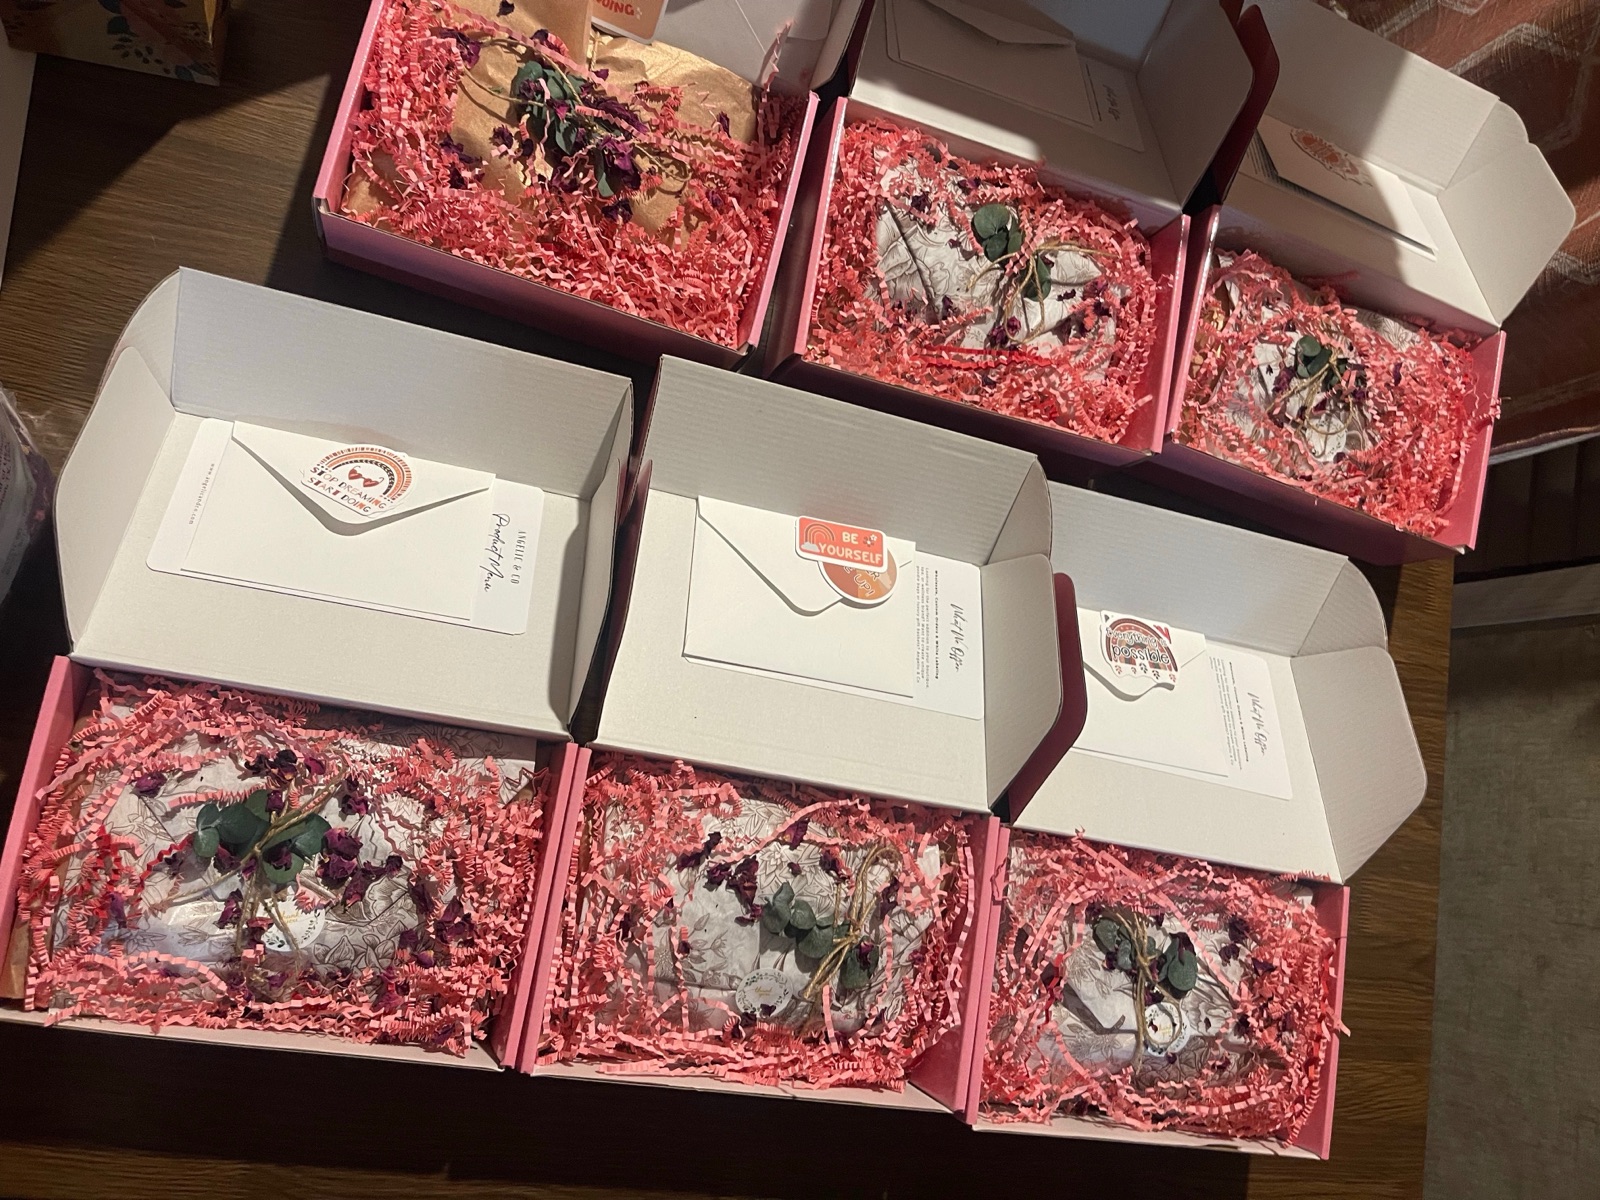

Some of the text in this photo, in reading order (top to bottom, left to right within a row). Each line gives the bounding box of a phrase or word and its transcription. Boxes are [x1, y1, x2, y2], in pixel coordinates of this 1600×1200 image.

[307, 476, 372, 513] START DOING
[309, 466, 387, 509] STOP DREAMING
[479, 513, 511, 592] Product Menu
[513, 530, 527, 562] ANGELIC
[818, 542, 883, 564] YOURSELF
[841, 531, 859, 544] BE
[510, 573, 521, 584] CO
[949, 603, 969, 673] What We Offer
[1112, 645, 1170, 665] possible
